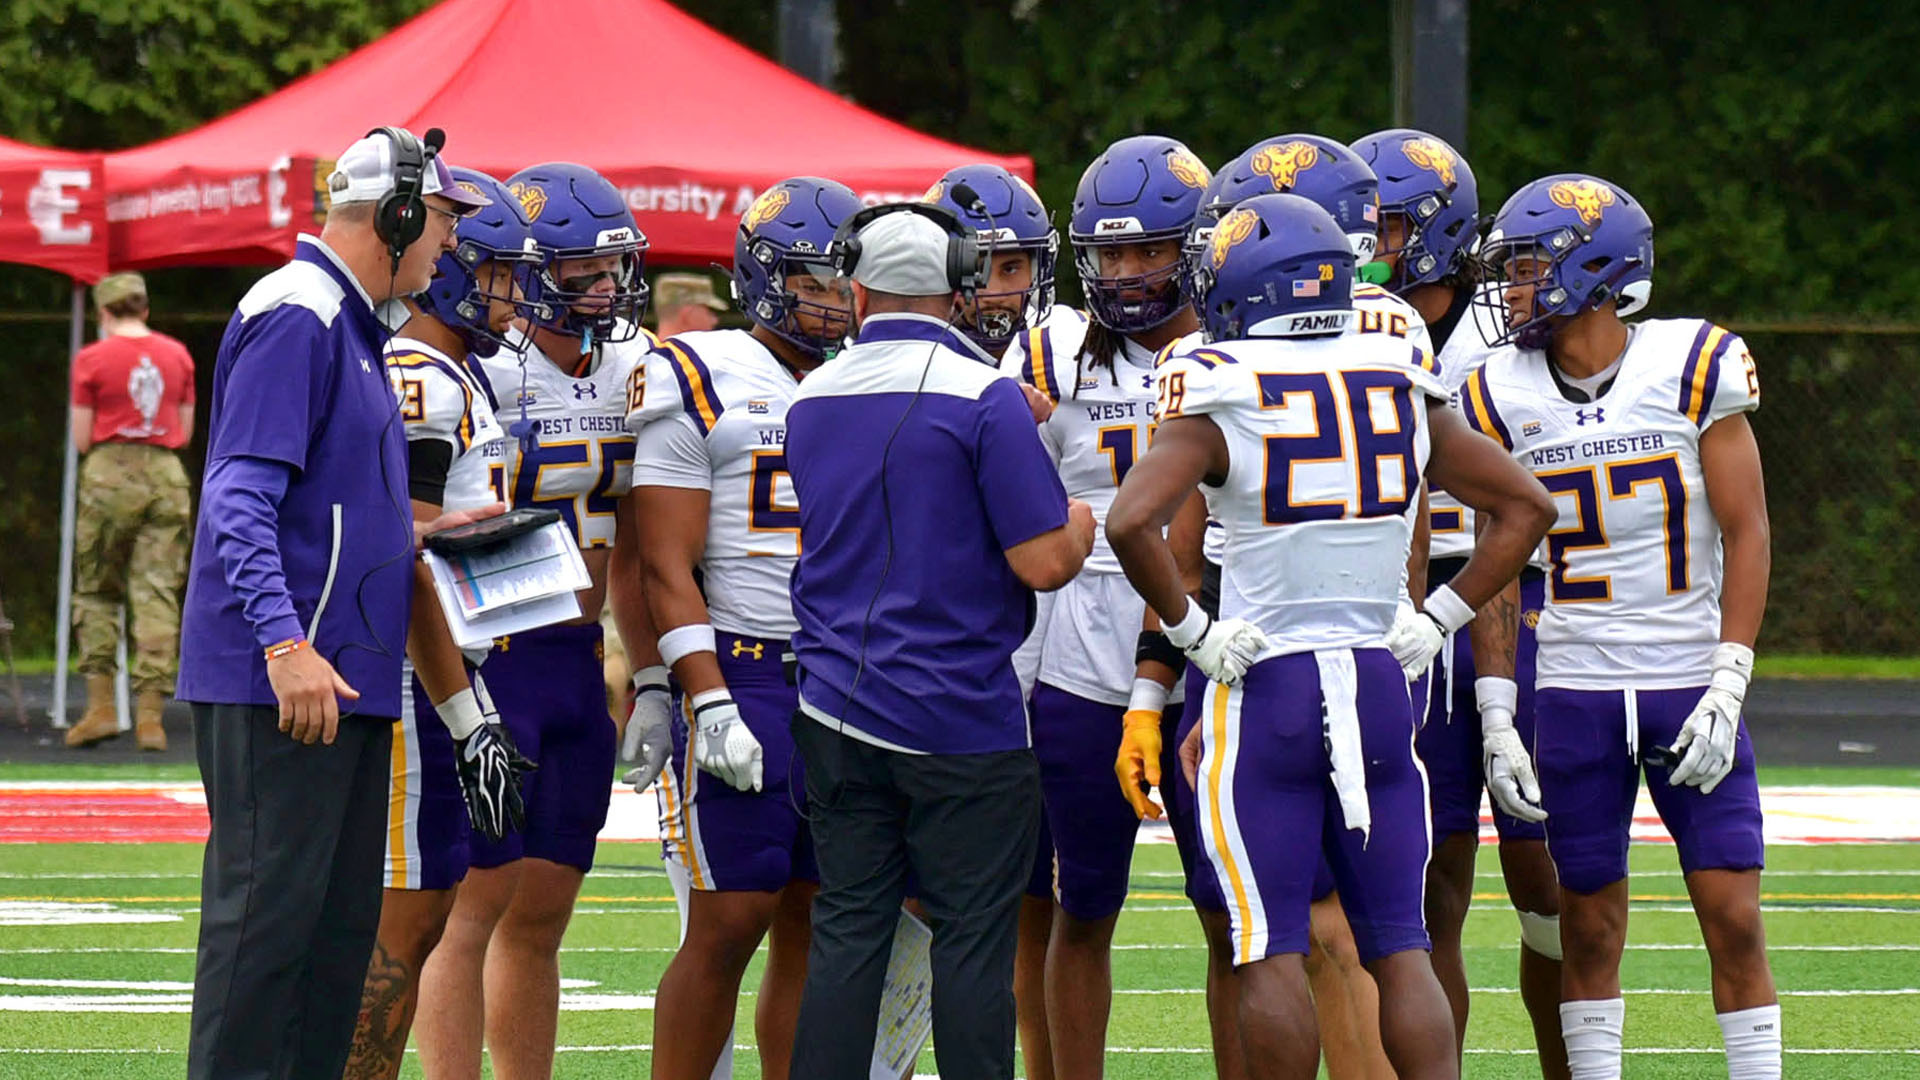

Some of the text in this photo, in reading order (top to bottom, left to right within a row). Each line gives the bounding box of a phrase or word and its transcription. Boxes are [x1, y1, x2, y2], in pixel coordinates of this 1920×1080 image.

[40, 169, 92, 245] E
[1318, 264, 1334, 281] 28
[390, 379, 426, 424] 3
[1087, 402, 1136, 420] WEST
[541, 415, 633, 435] EST CHESTE
[759, 430, 785, 445] WE
[1254, 369, 1420, 527] 28
[1531, 434, 1664, 465] WEST CHESTER
[1534, 452, 1690, 604] 27
